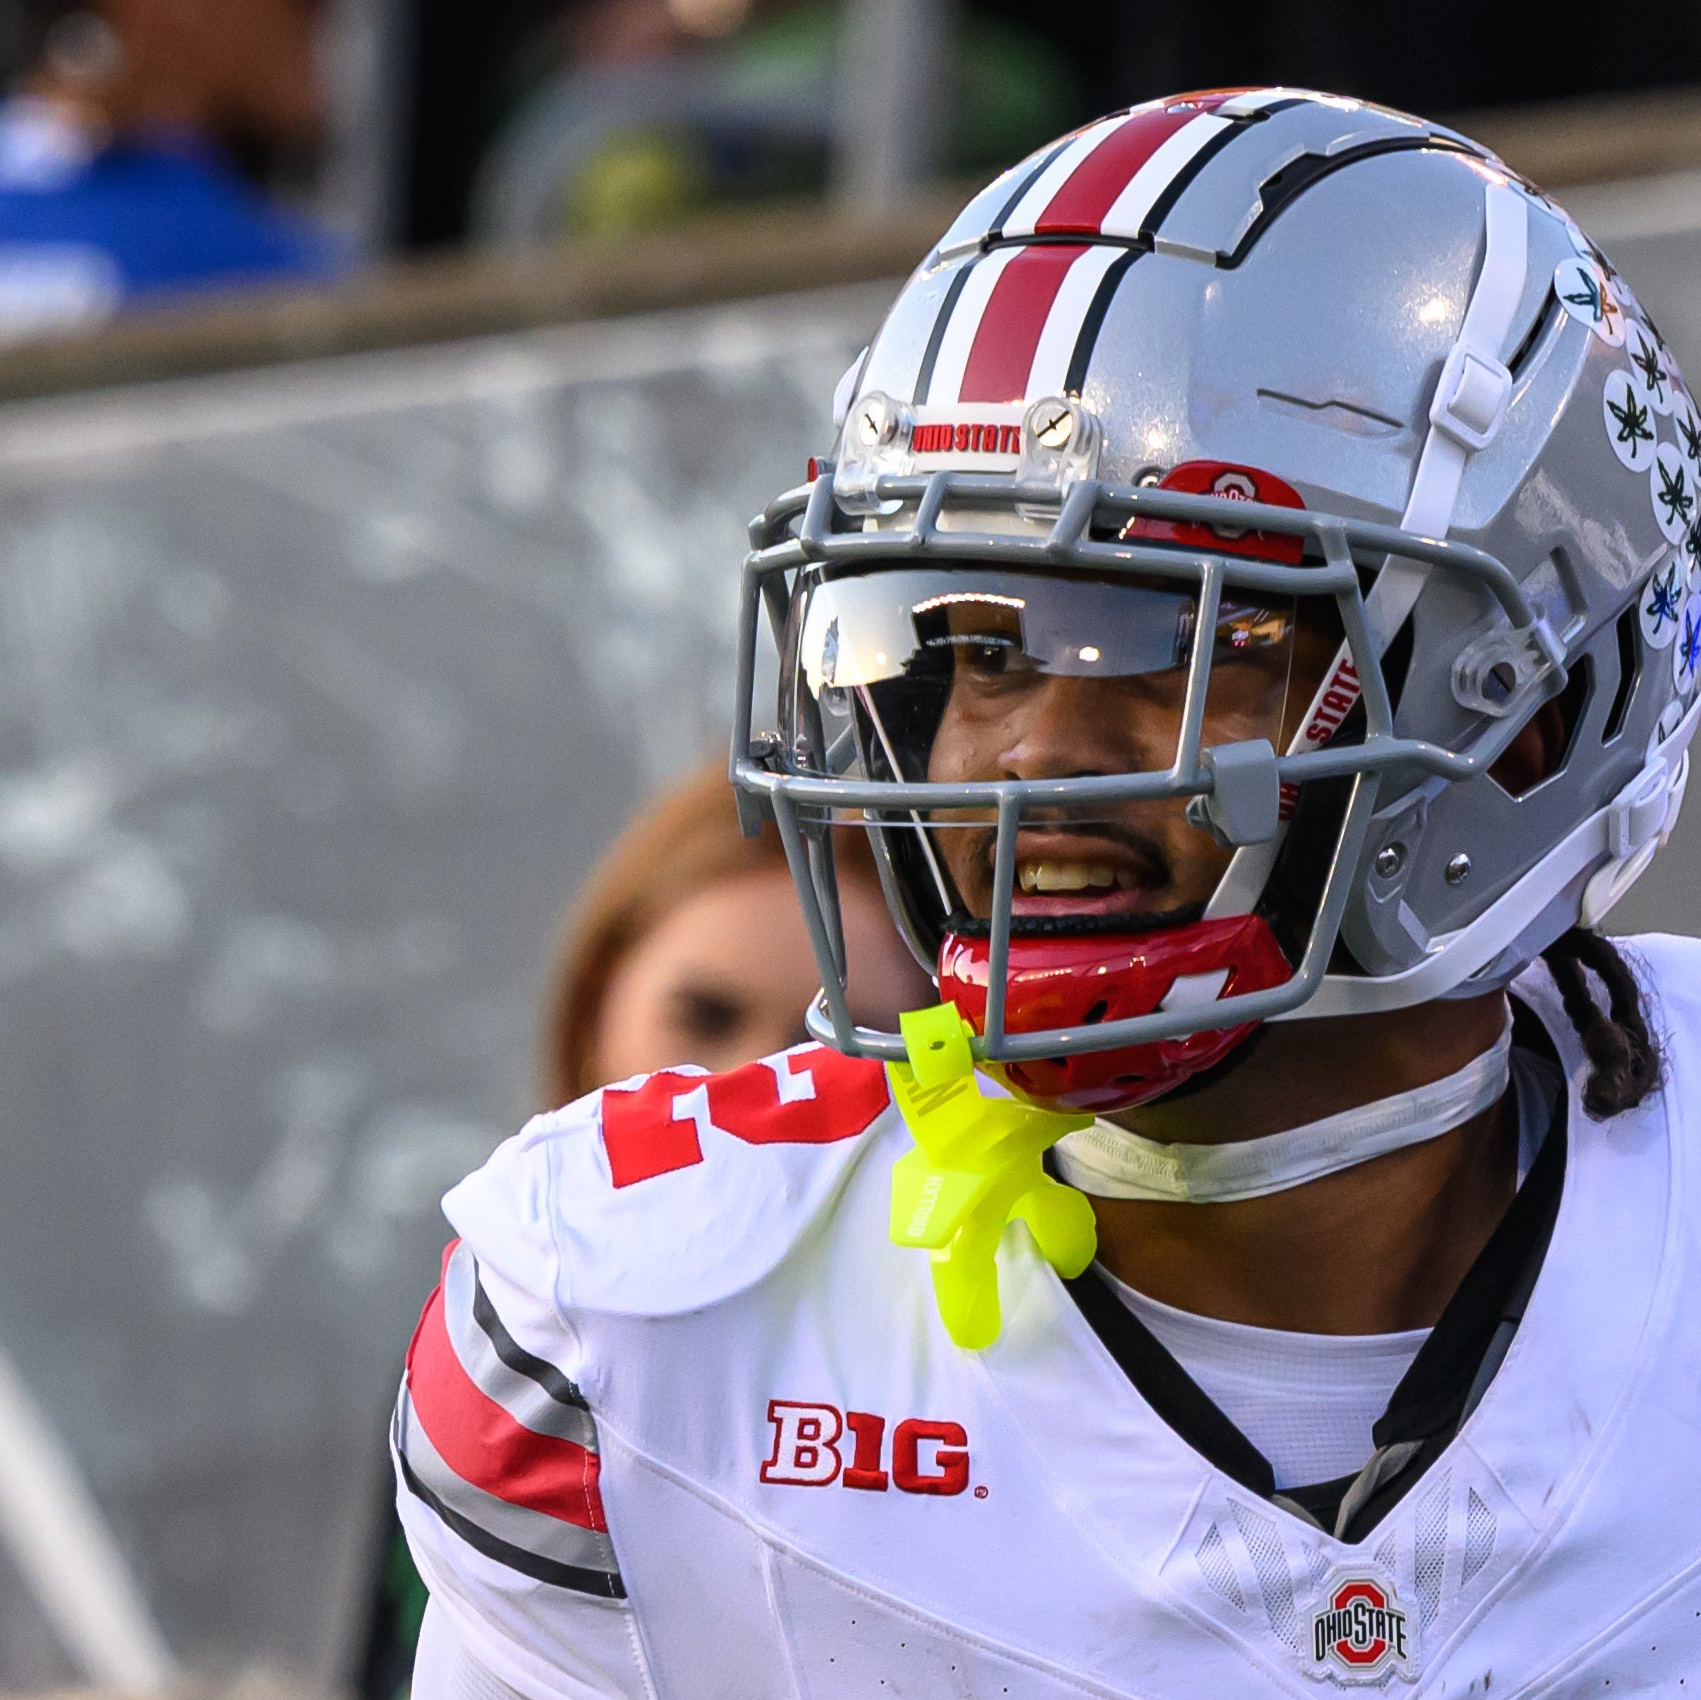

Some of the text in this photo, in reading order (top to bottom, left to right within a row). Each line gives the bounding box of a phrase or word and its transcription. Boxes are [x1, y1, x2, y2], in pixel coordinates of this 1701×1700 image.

[912, 424, 954, 452] OHIO
[1314, 1602, 1407, 1662] OHIO STATE
